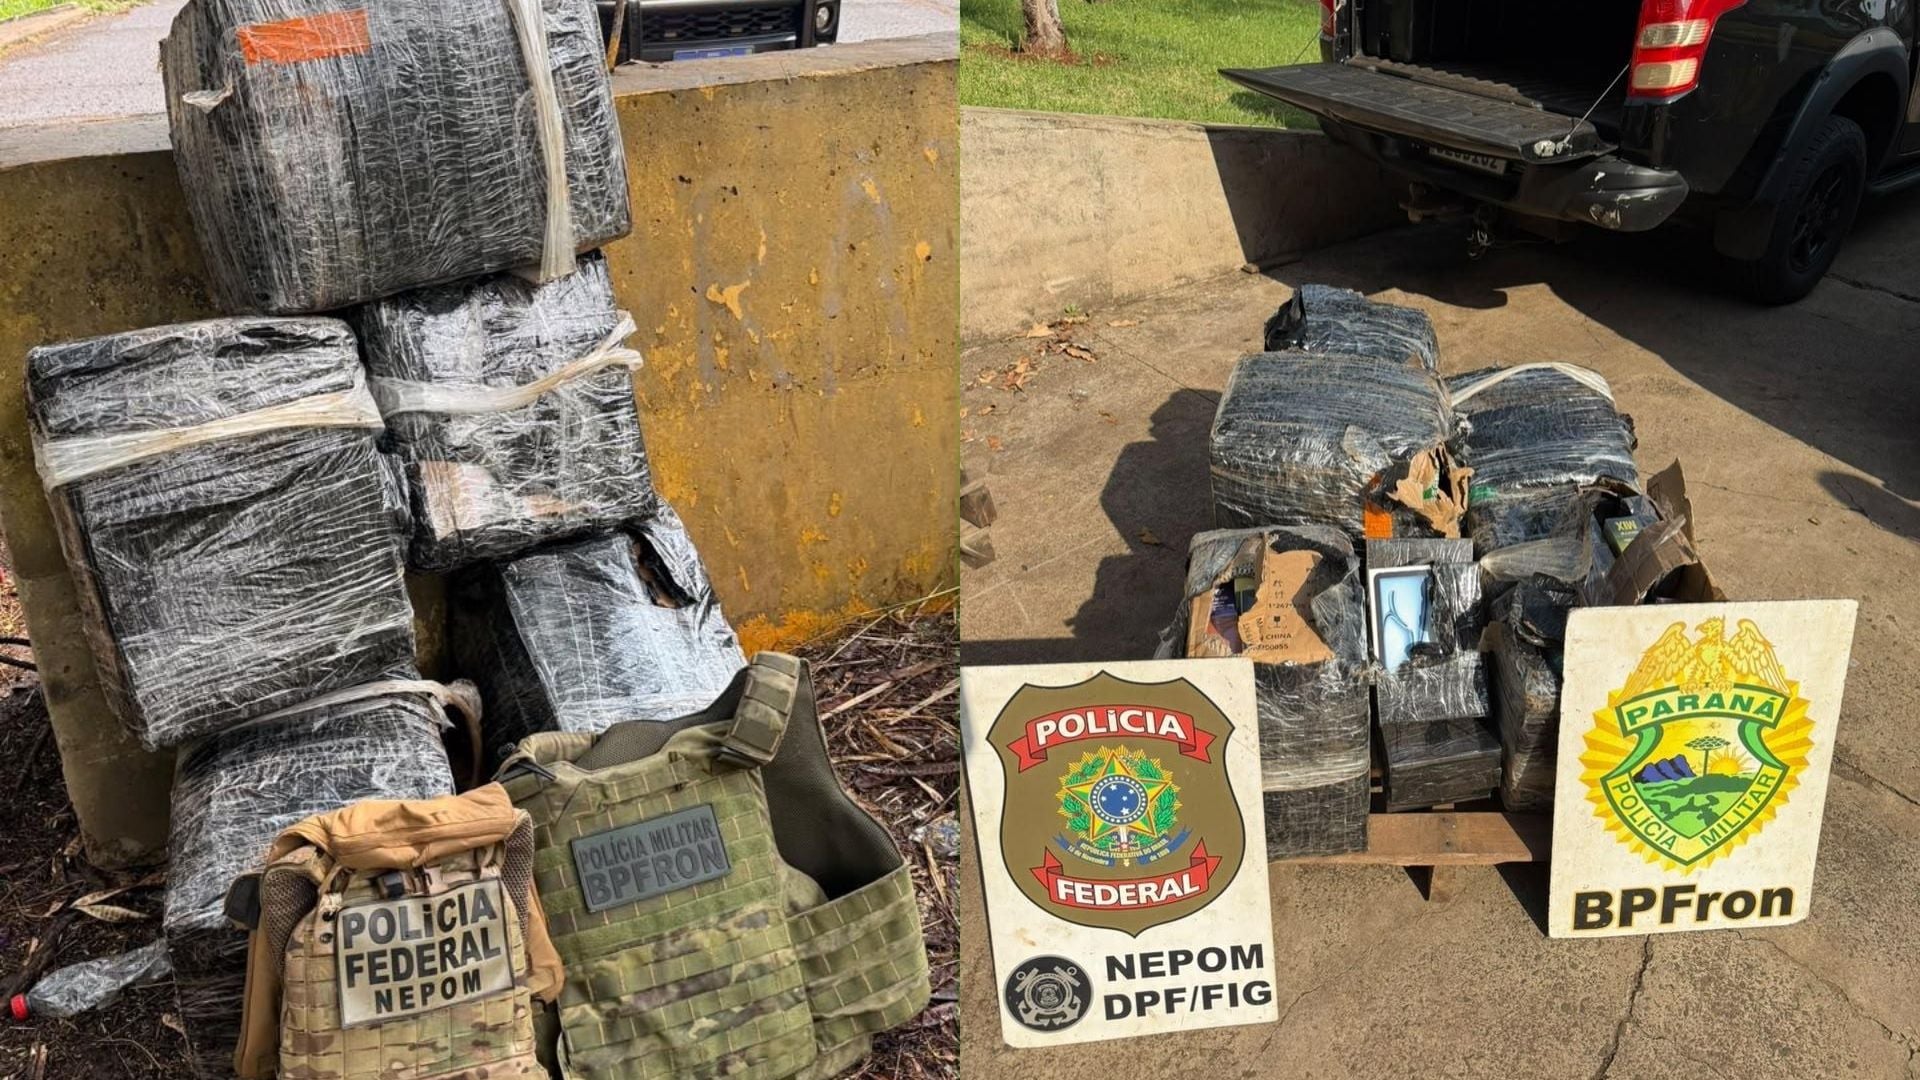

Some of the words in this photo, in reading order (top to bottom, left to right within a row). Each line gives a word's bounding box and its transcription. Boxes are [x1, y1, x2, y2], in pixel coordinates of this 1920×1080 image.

[1265, 633, 1292, 641] CHINA
[1625, 692, 1776, 727] PARANÁ
[1612, 780, 1680, 850] POLÍCIA
[1700, 773, 1776, 847] MILITAR
[578, 834, 648, 873] POLÍCIA
[648, 817, 717, 853] MILITAR
[585, 838, 726, 906] BPFRON
[1056, 873, 1201, 907] FEDERAL
[1573, 884, 1794, 931] BPFron
[345, 927, 502, 989] FEDERAL
[1105, 943, 1264, 982] NEPOM
[375, 968, 482, 1015] NEPOM
[1104, 980, 1272, 1021] DPF/FIG
